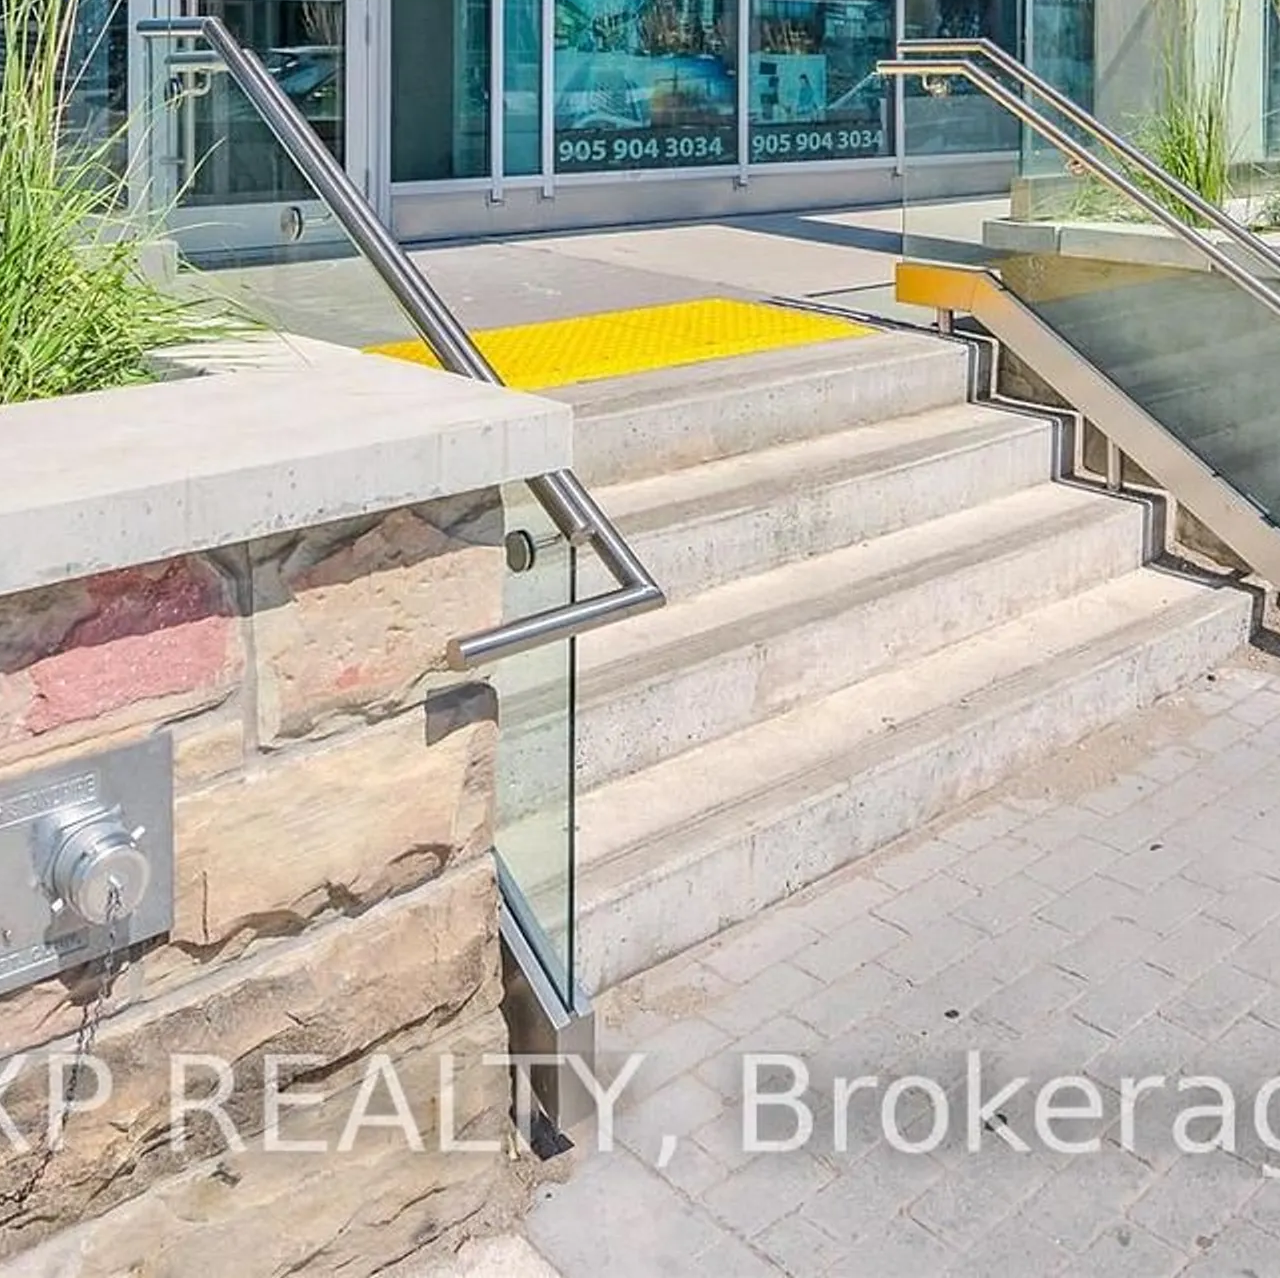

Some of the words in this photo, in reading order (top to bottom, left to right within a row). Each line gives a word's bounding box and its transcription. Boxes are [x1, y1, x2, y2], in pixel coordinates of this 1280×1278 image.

[559, 139, 606, 162] 905
[613, 138, 660, 160] 904
[665, 136, 723, 159] 3034
[751, 133, 791, 155] 905
[795, 131, 833, 152] 904
[838, 129, 884, 149] 3034
